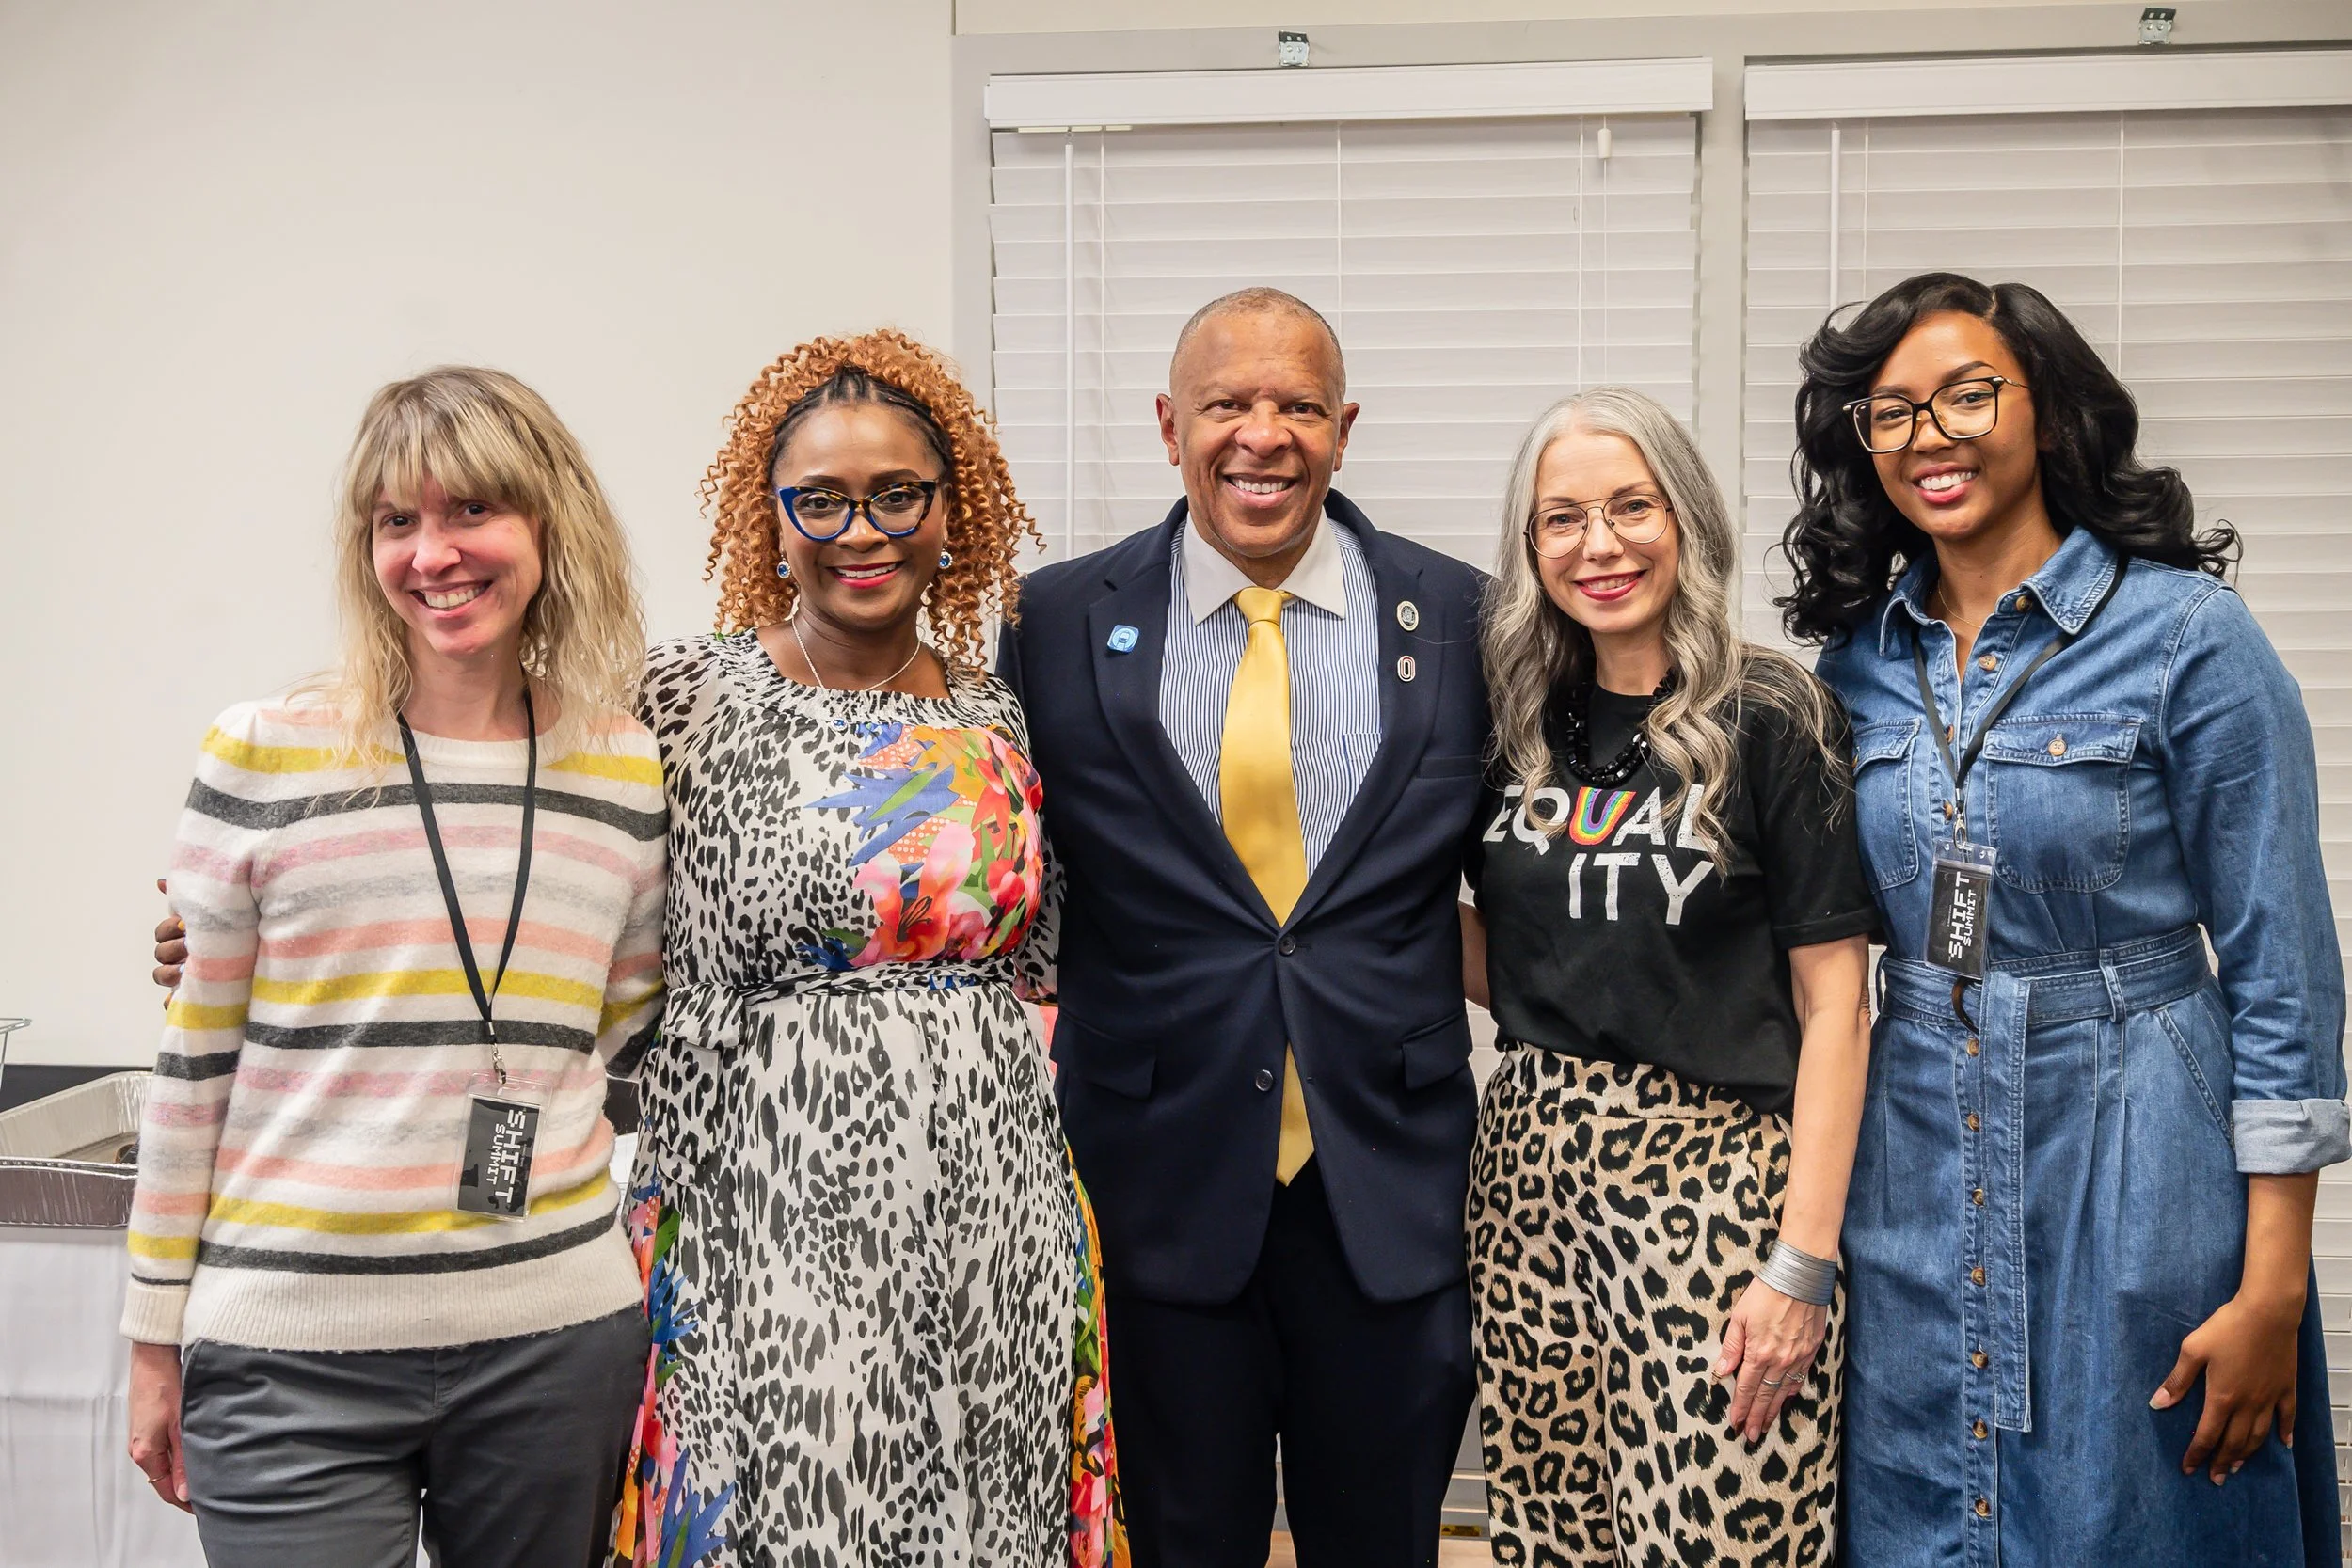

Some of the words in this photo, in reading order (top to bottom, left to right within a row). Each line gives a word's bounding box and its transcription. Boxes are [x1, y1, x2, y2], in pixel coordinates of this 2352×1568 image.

[1483, 784, 1719, 855] EQUAL
[1569, 853, 1714, 926] ITY
[1948, 871, 1970, 959] SHIFT
[1963, 889, 1977, 947] SUMMIT
[486, 1123, 506, 1185] SUMMIT
[495, 1109, 526, 1203] SHIFT
